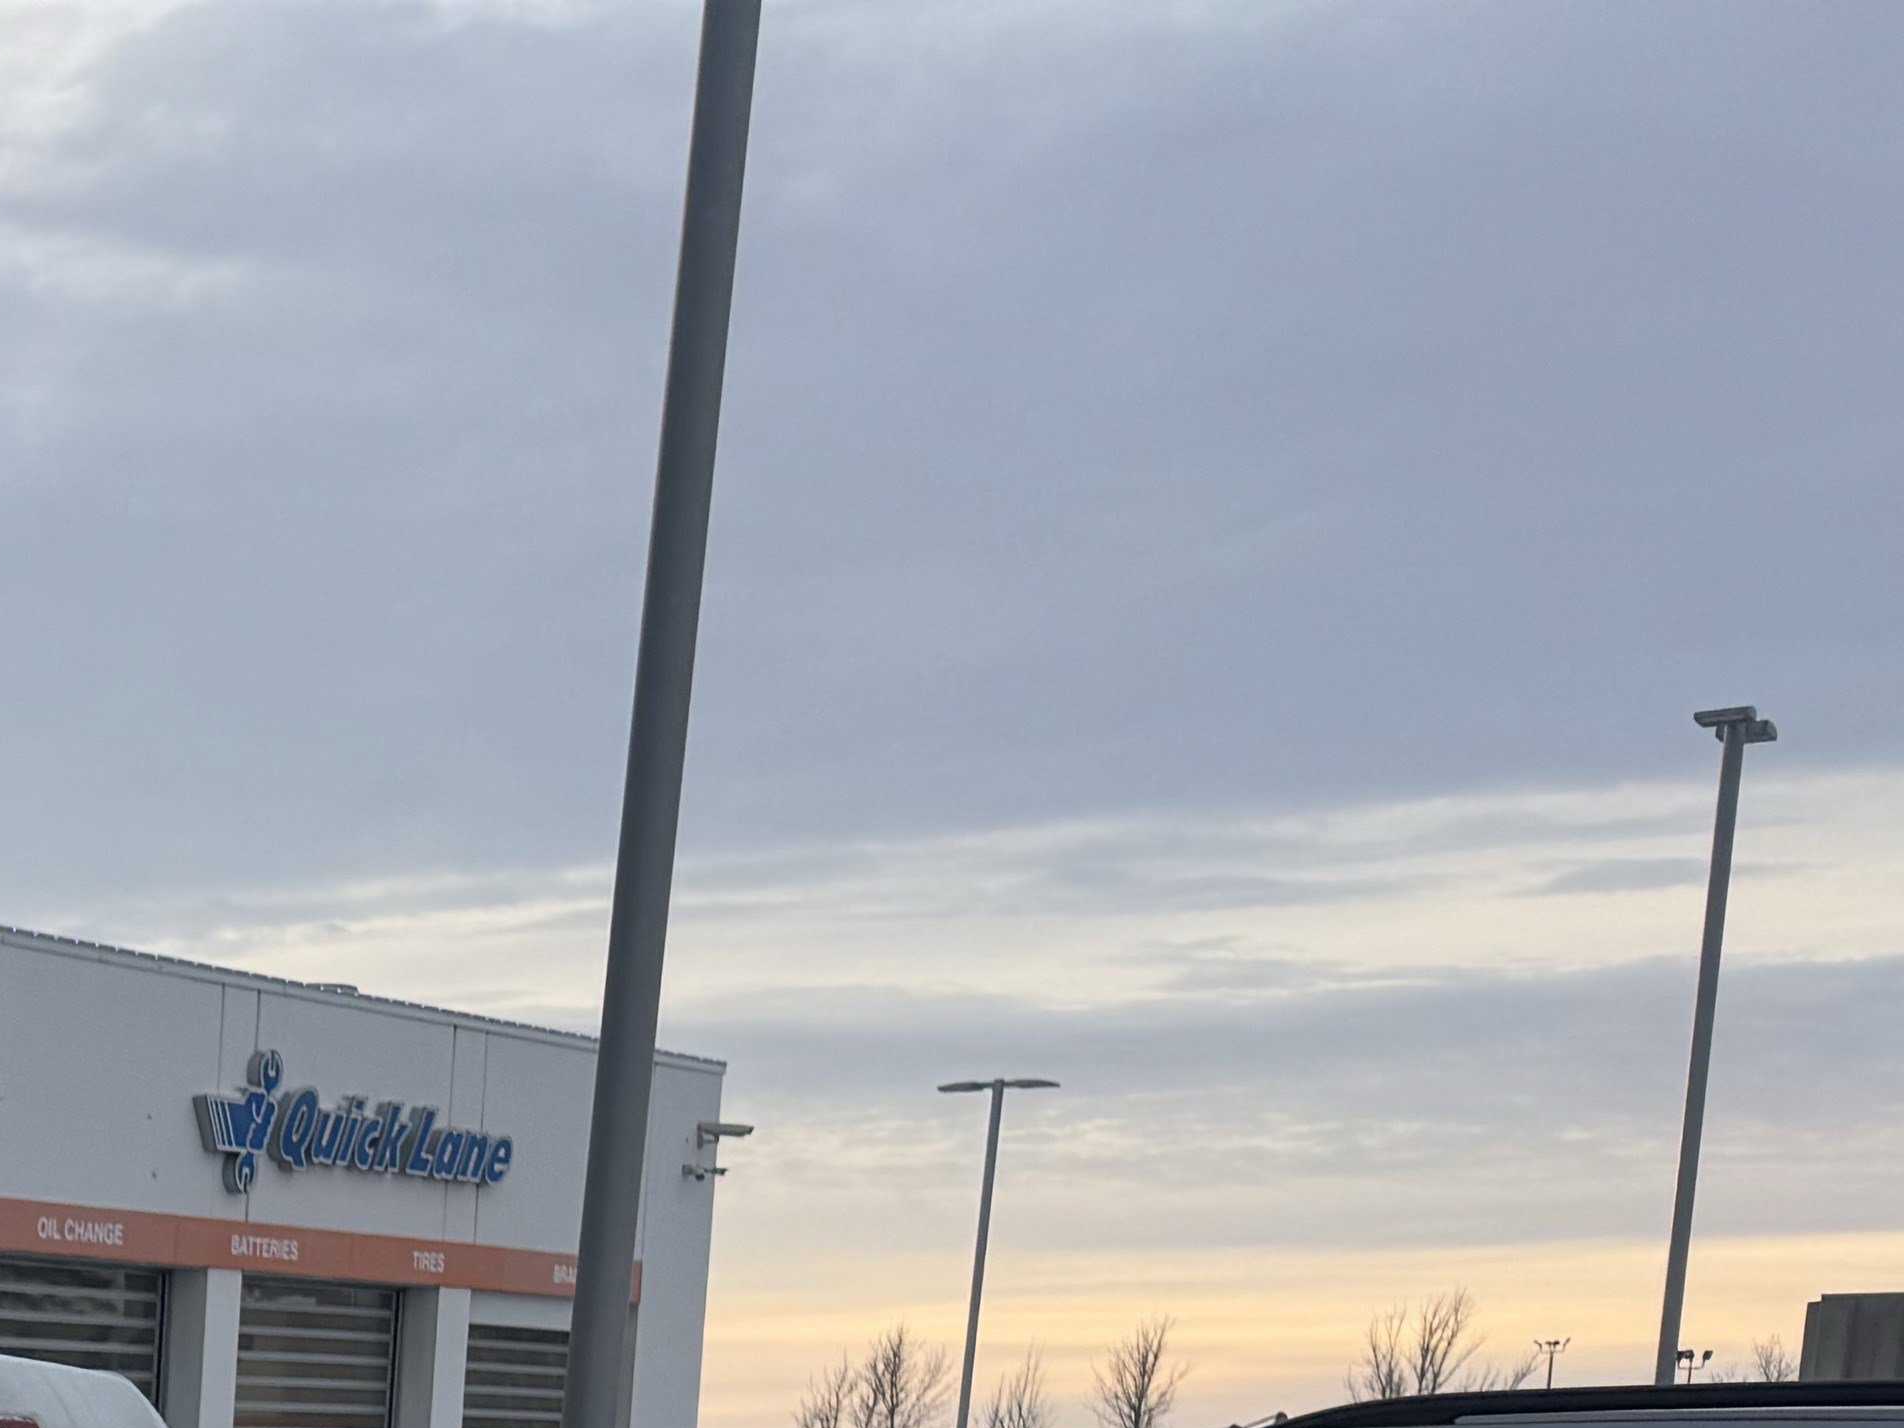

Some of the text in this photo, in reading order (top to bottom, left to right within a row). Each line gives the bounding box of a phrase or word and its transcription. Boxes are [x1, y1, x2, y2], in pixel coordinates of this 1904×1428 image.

[279, 1086, 513, 1185] Quick Lane
[37, 1216, 124, 1246] OIL CHANGE
[231, 1233, 299, 1261] BATTERIES
[413, 1250, 445, 1273] TIRES
[553, 1263, 578, 1284] BRA
